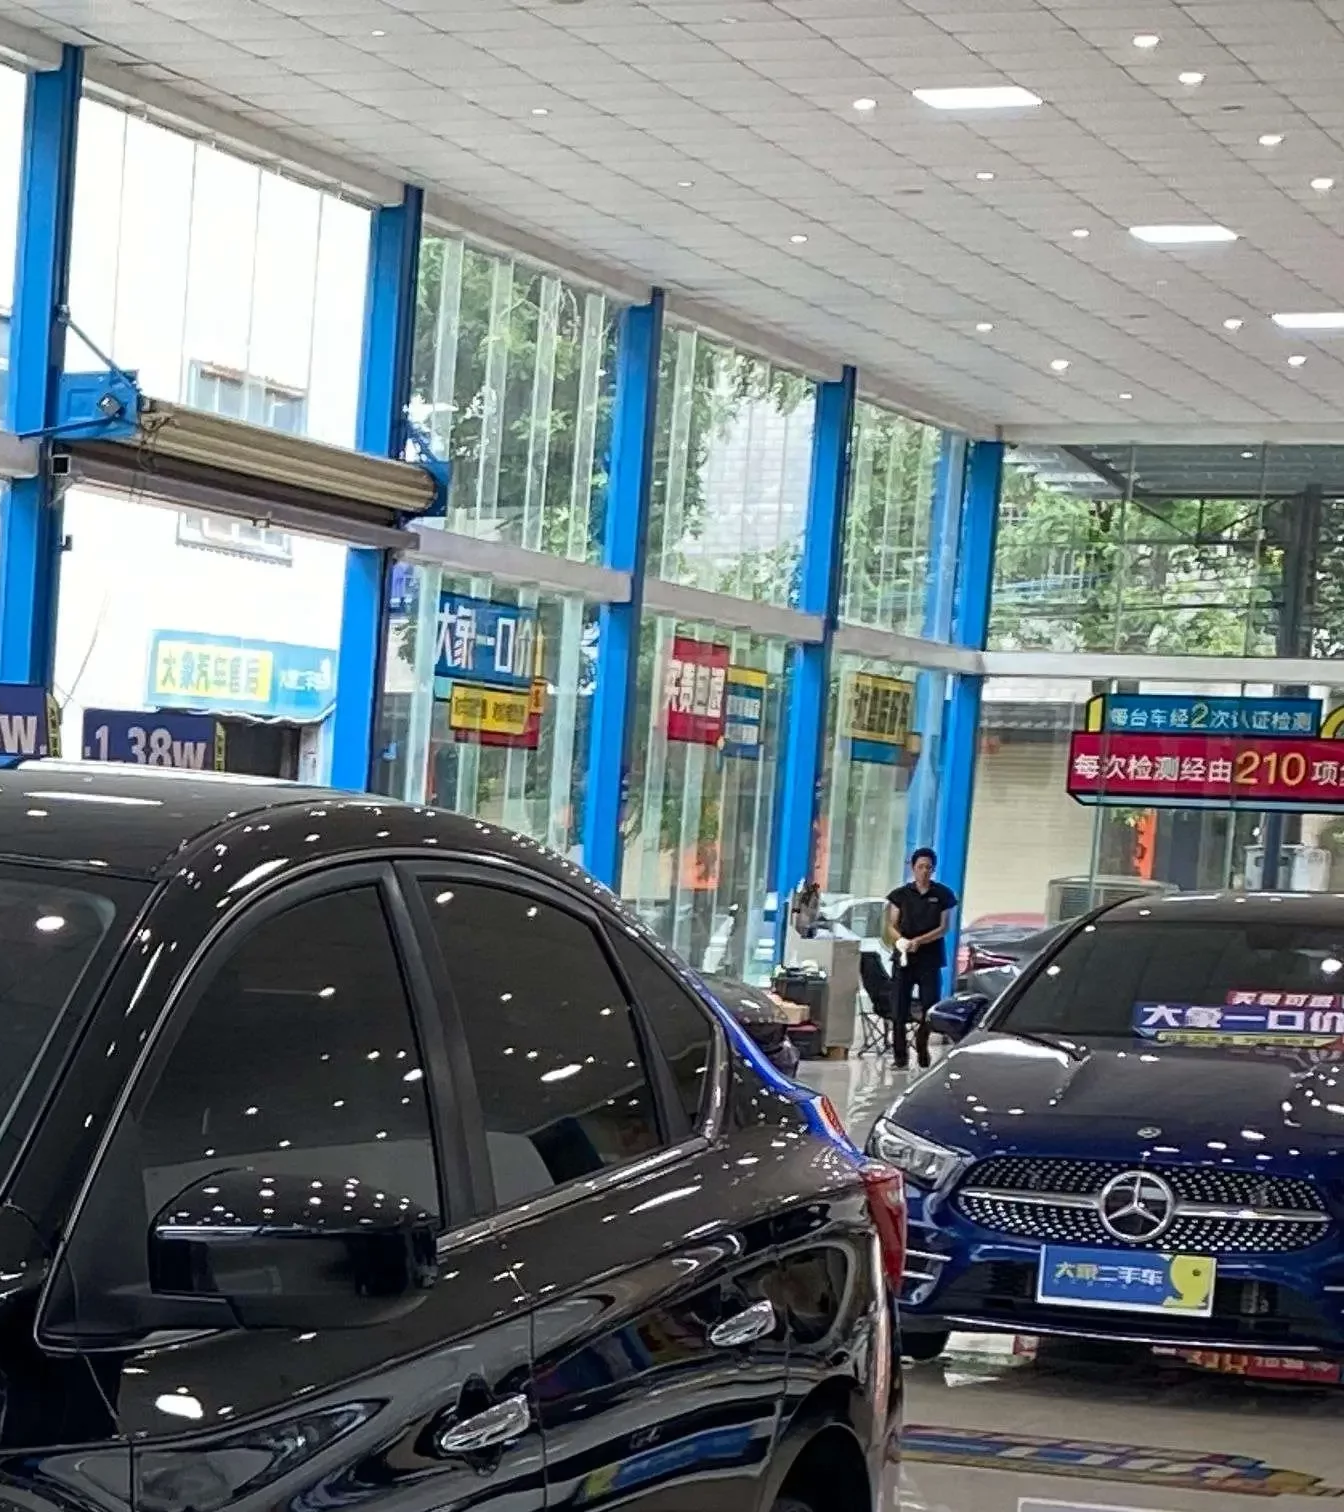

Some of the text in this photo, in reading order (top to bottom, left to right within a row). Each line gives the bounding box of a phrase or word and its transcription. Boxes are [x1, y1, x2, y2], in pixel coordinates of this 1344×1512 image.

[1074, 751, 1344, 787] 每次检测经由210项
[1142, 1005, 1344, 1033] 大象一口价
[1055, 1262, 1164, 1286] 大象二手车
